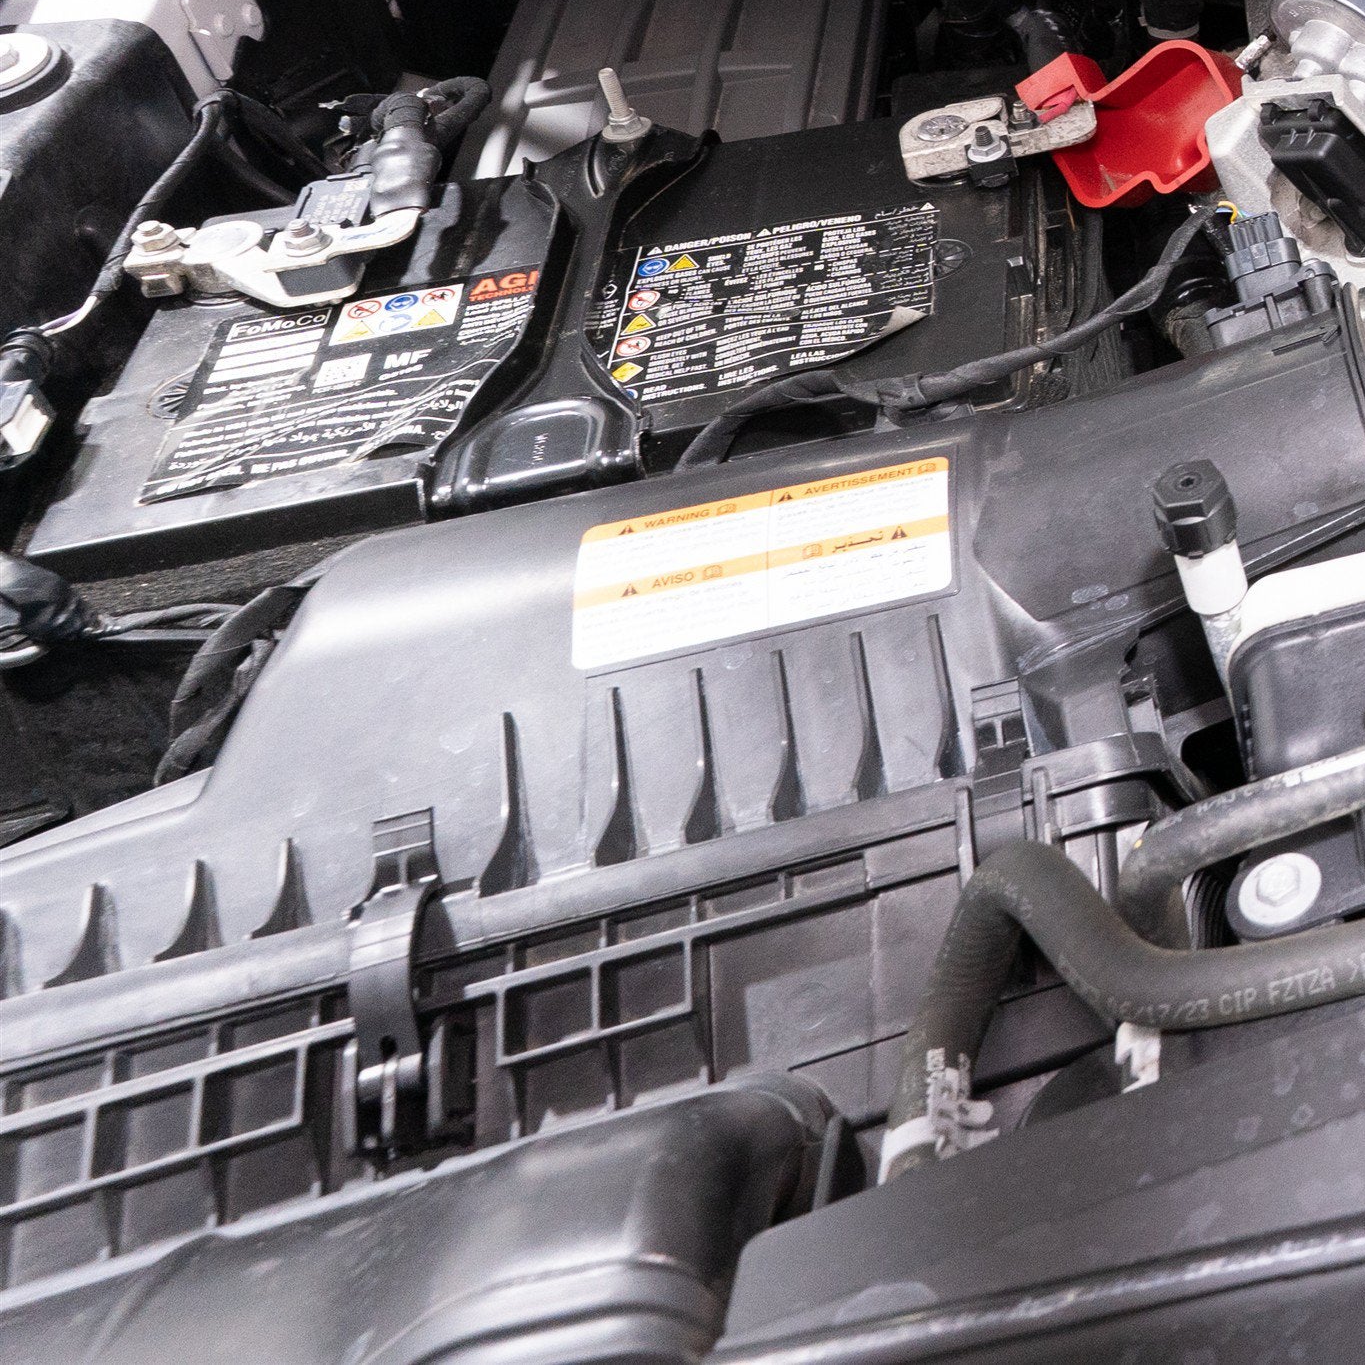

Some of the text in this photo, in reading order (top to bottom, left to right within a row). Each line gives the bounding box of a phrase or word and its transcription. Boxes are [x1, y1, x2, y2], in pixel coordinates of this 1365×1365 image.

[232, 312, 328, 339] FoMoCo
[383, 348, 433, 370] MF
[803, 467, 915, 496] AVERTISSEMENT
[643, 508, 711, 530] WARNING
[831, 531, 885, 555] تحذير
[651, 571, 695, 589] AVISO
[1217, 986, 1258, 1016] CIP
